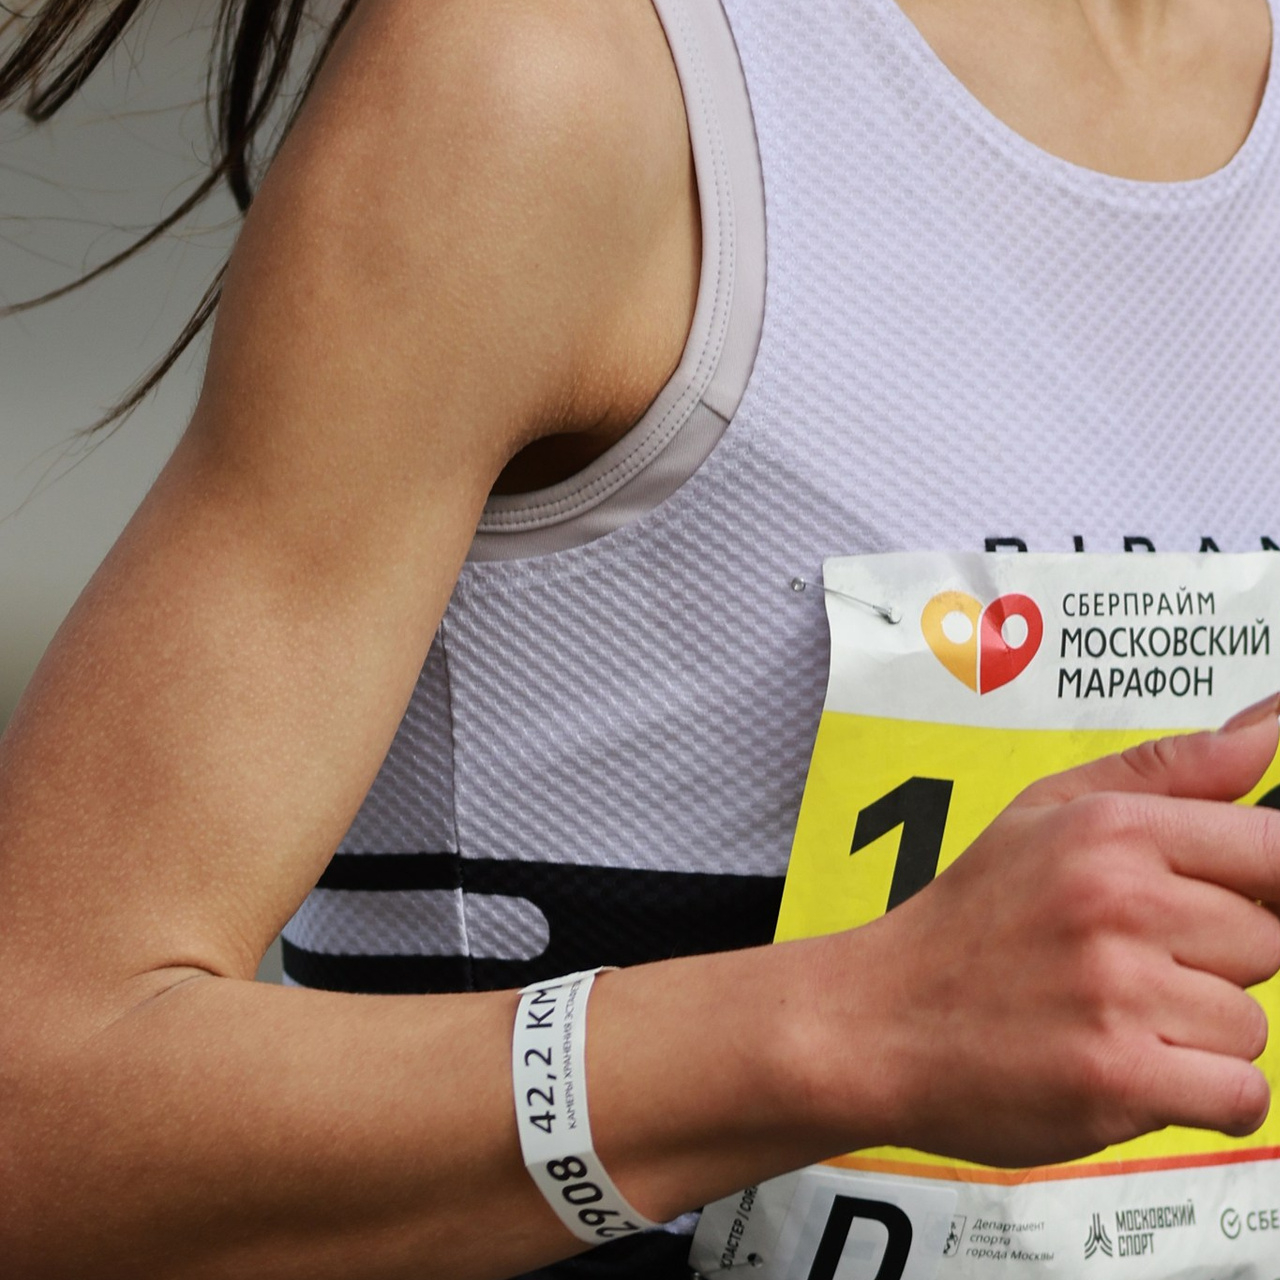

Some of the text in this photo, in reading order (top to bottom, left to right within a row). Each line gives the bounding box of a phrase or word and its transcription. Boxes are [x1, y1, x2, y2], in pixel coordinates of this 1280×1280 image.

[1062, 587, 1216, 617] СБЕРПРАЙМ
[1060, 618, 1270, 658] МОСКОВСКИЙ
[1057, 666, 1214, 698] МАРАФОН
[525, 985, 562, 1134] 42,2 КМ
[563, 1023, 574, 1079] ХРАНЕНИЯ
[564, 1082, 577, 1130] КАМЕРЫ
[546, 1156, 640, 1238] 2908
[972, 1218, 1045, 1233] Департамент
[1115, 1198, 1196, 1232] МОСКОВСКИЙ
[720, 1218, 745, 1270] КЛАСТЕР
[966, 1248, 1054, 1261] города Москвы
[970, 1233, 1011, 1246] спорта
[1118, 1232, 1154, 1257] СПОРТ
